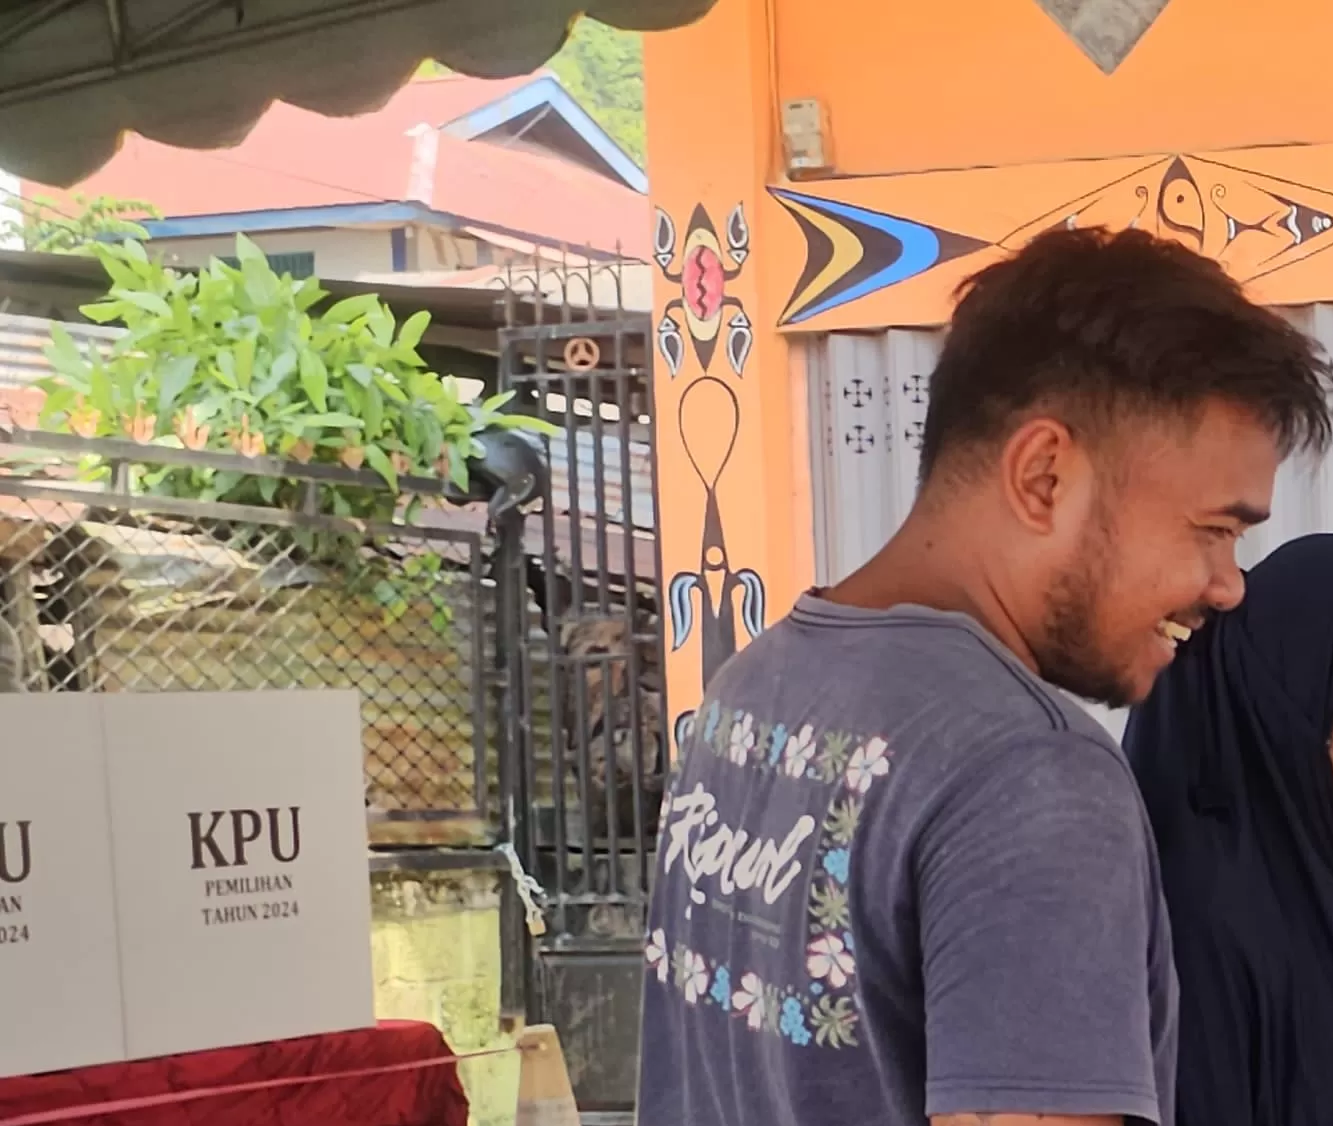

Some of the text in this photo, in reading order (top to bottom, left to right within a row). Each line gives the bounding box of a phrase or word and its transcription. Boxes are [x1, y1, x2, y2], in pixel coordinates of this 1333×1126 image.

[187, 806, 301, 869] KPU
[204, 874, 293, 897] PEMILIHAN
[201, 901, 299, 925] TAHUN 2024
[0, 924, 29, 944] 024
